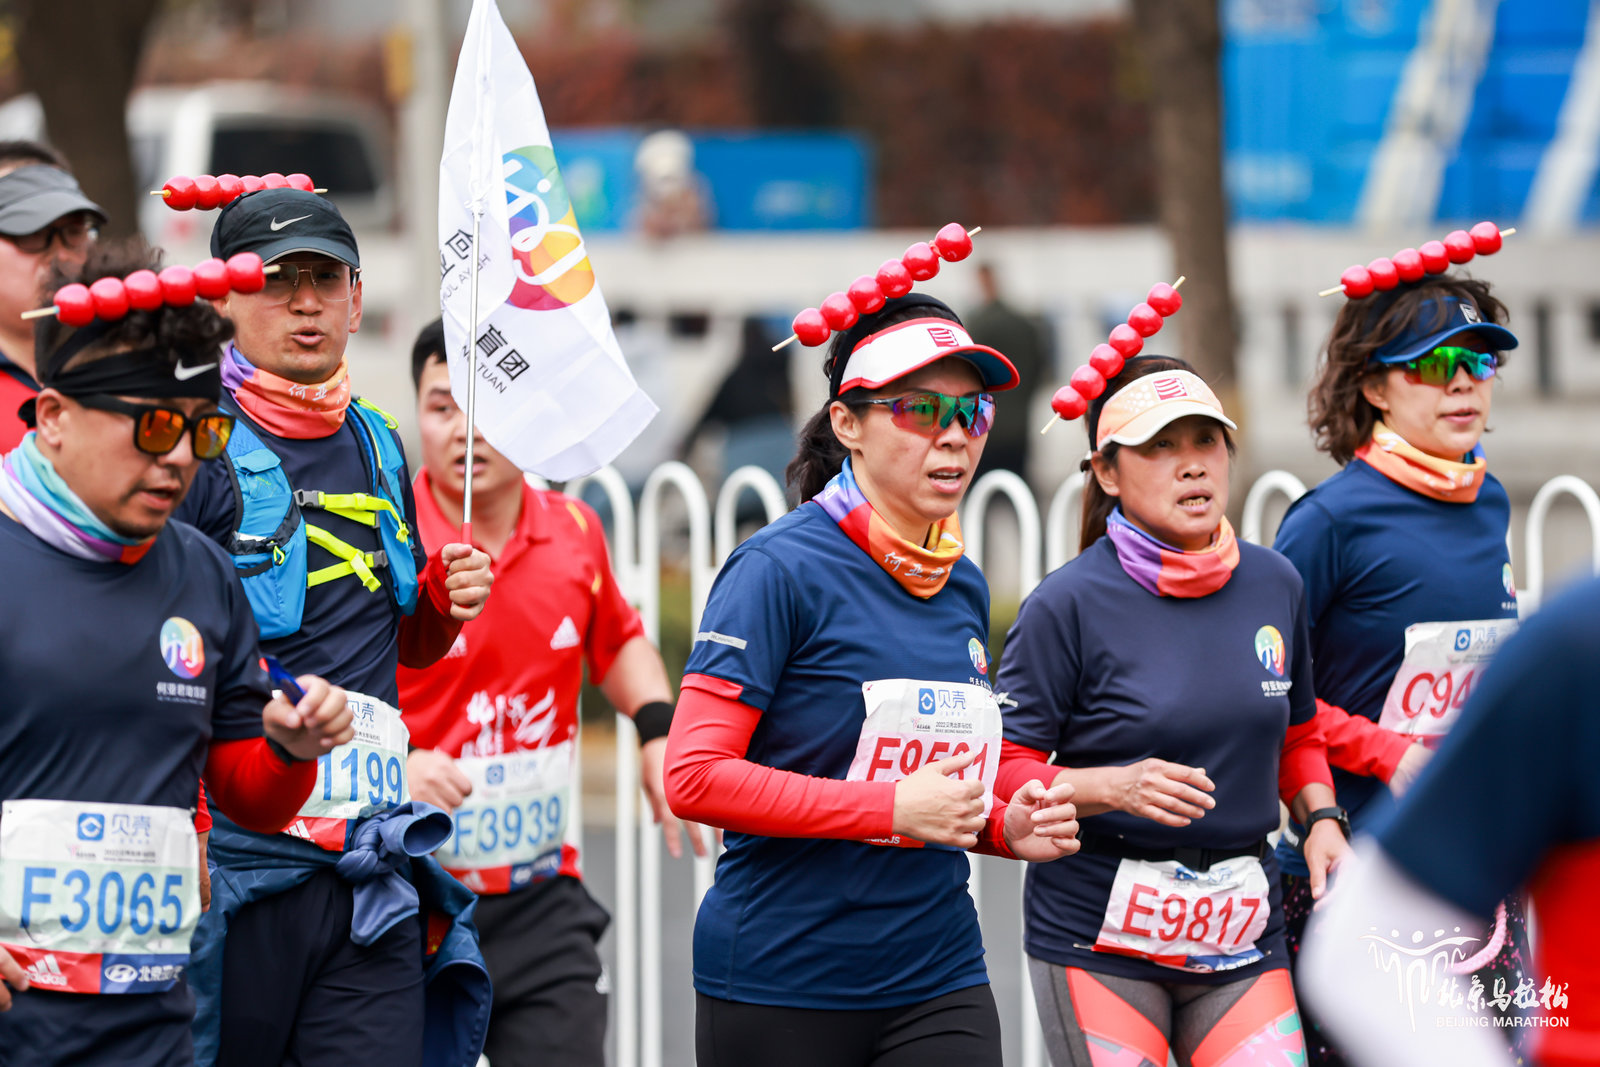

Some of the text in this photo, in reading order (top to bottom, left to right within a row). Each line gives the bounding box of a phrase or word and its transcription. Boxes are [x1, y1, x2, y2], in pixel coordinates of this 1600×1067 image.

[476, 324, 530, 381] 盲团
[476, 364, 508, 394] TUAN
[938, 689, 967, 710] 贝壳
[1402, 669, 1486, 719] C94
[111, 813, 152, 838] 贝壳
[454, 795, 561, 856] F3939
[19, 866, 183, 936] F3065
[1121, 883, 1260, 945] E9817
